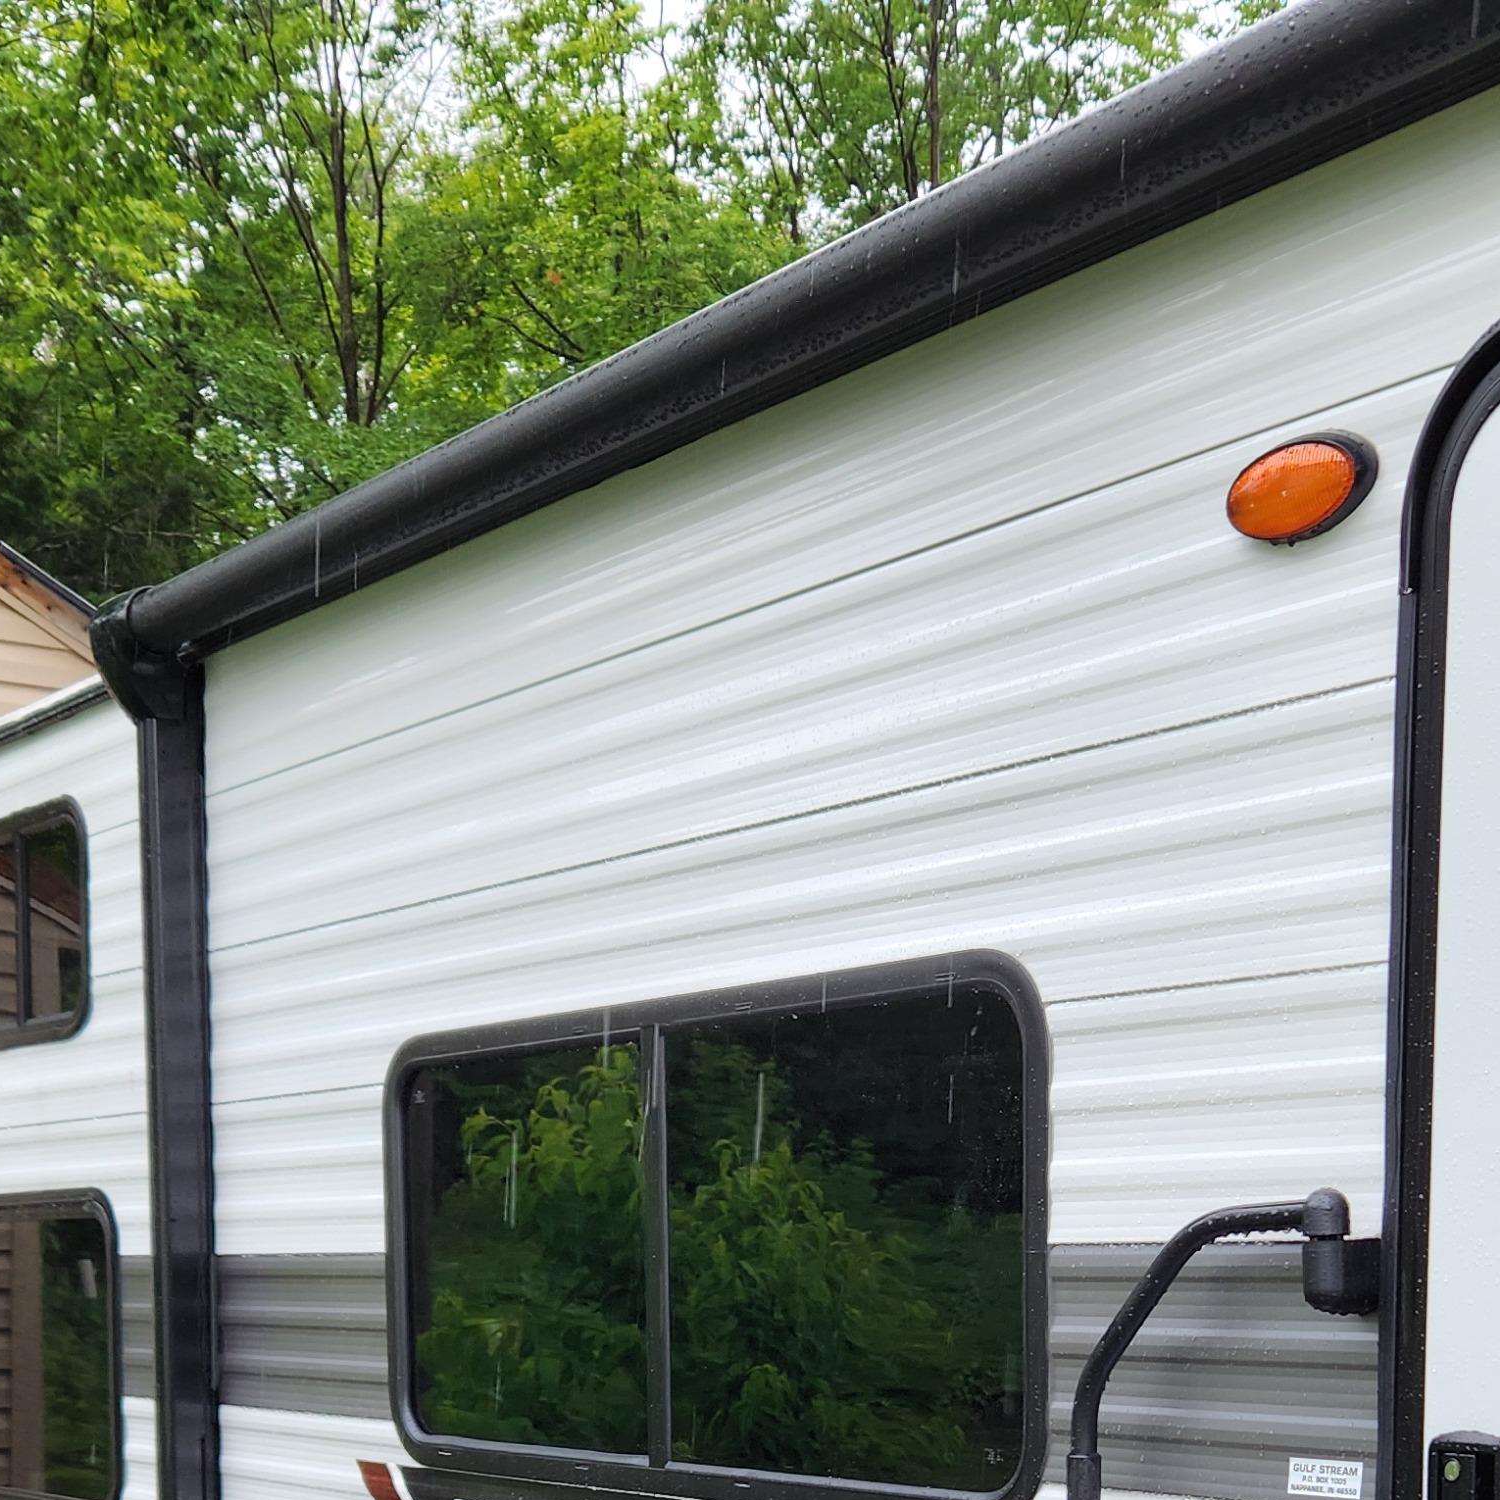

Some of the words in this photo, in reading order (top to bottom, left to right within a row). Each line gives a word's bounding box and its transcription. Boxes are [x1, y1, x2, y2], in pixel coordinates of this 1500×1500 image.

[1293, 1463, 1316, 1473] GULF
[1319, 1465, 1358, 1476] STREAM
[1316, 1476, 1328, 1484] BOX
